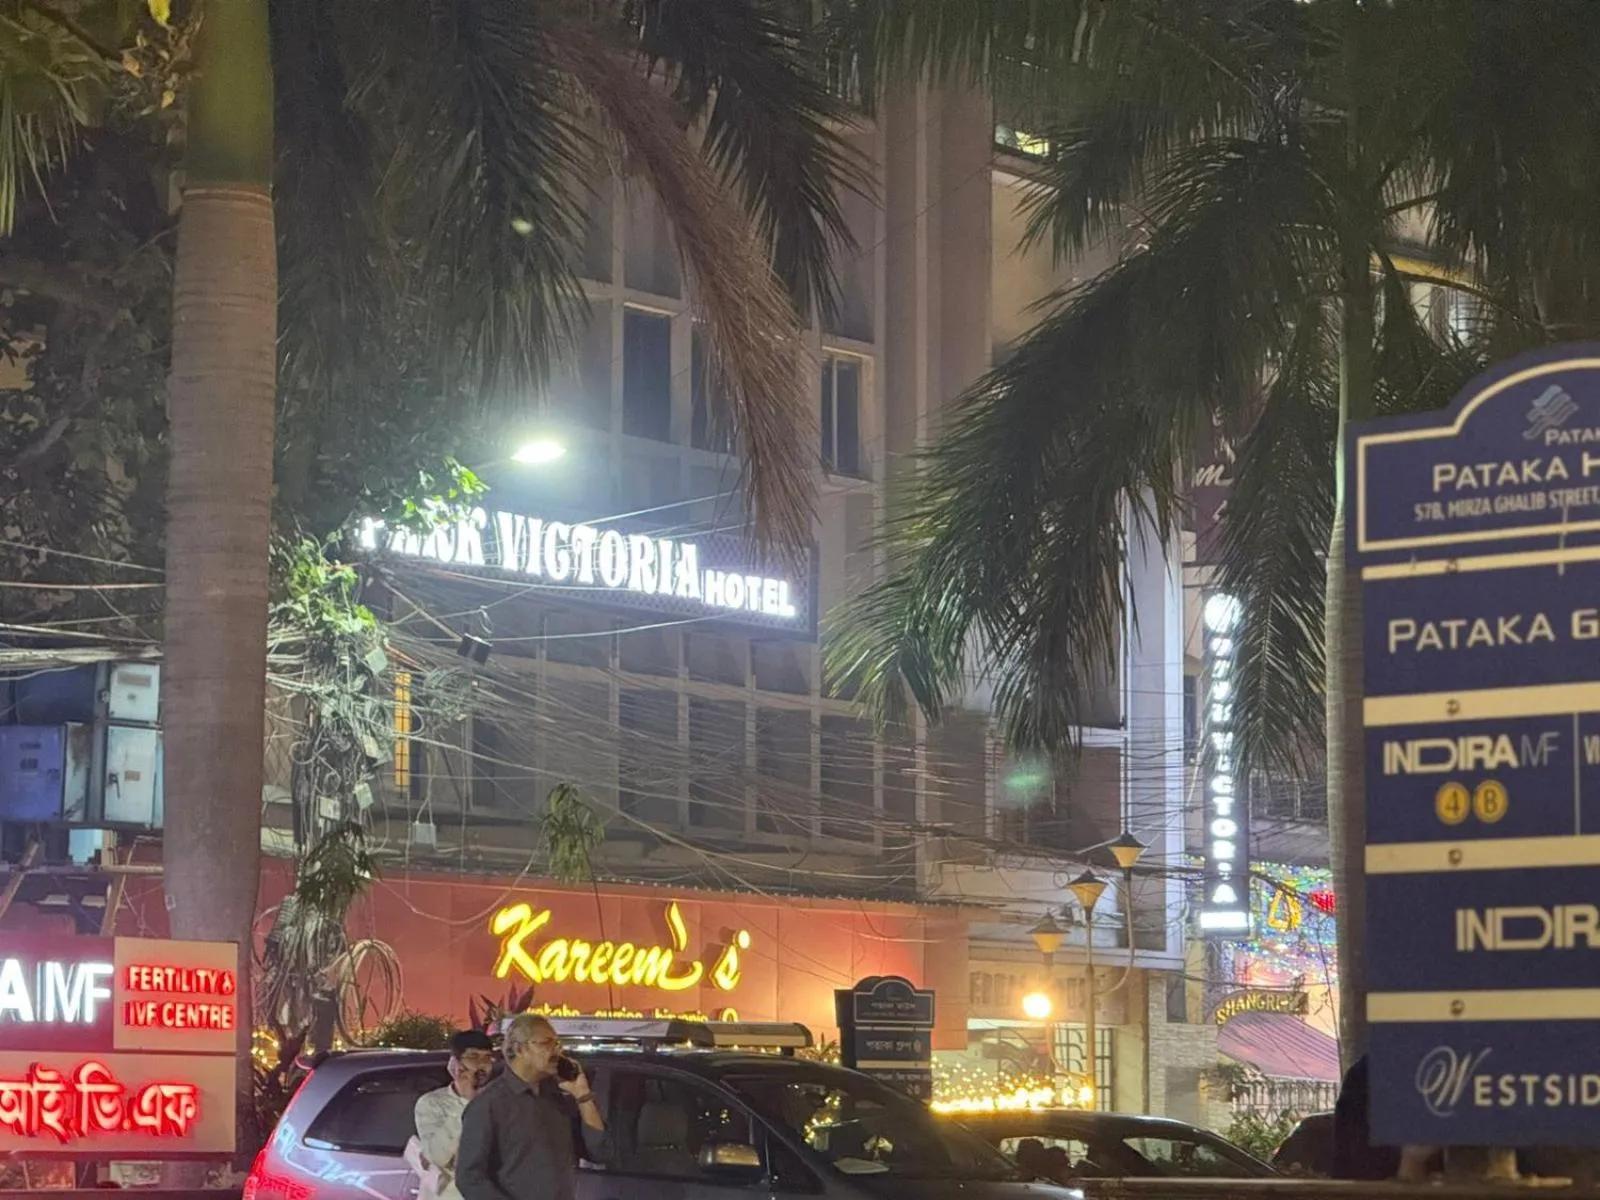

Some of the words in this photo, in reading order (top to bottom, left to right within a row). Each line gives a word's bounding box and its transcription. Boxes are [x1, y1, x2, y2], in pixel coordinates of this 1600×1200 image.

[1545, 427, 1600, 446] PATA
[1432, 456, 1569, 492] PATAKA
[496, 511, 701, 599] VICTORIA
[703, 568, 797, 618] HOTEL
[1388, 612, 1556, 654] PATAKA
[1383, 734, 1519, 776] INDIRA
[1456, 904, 1600, 952] INDIR
[126, 965, 217, 993] FERTILITY
[125, 1002, 157, 1025] IVF
[161, 1003, 234, 1029] CENTRE
[1215, 992, 1303, 1025] SHANGRI-
